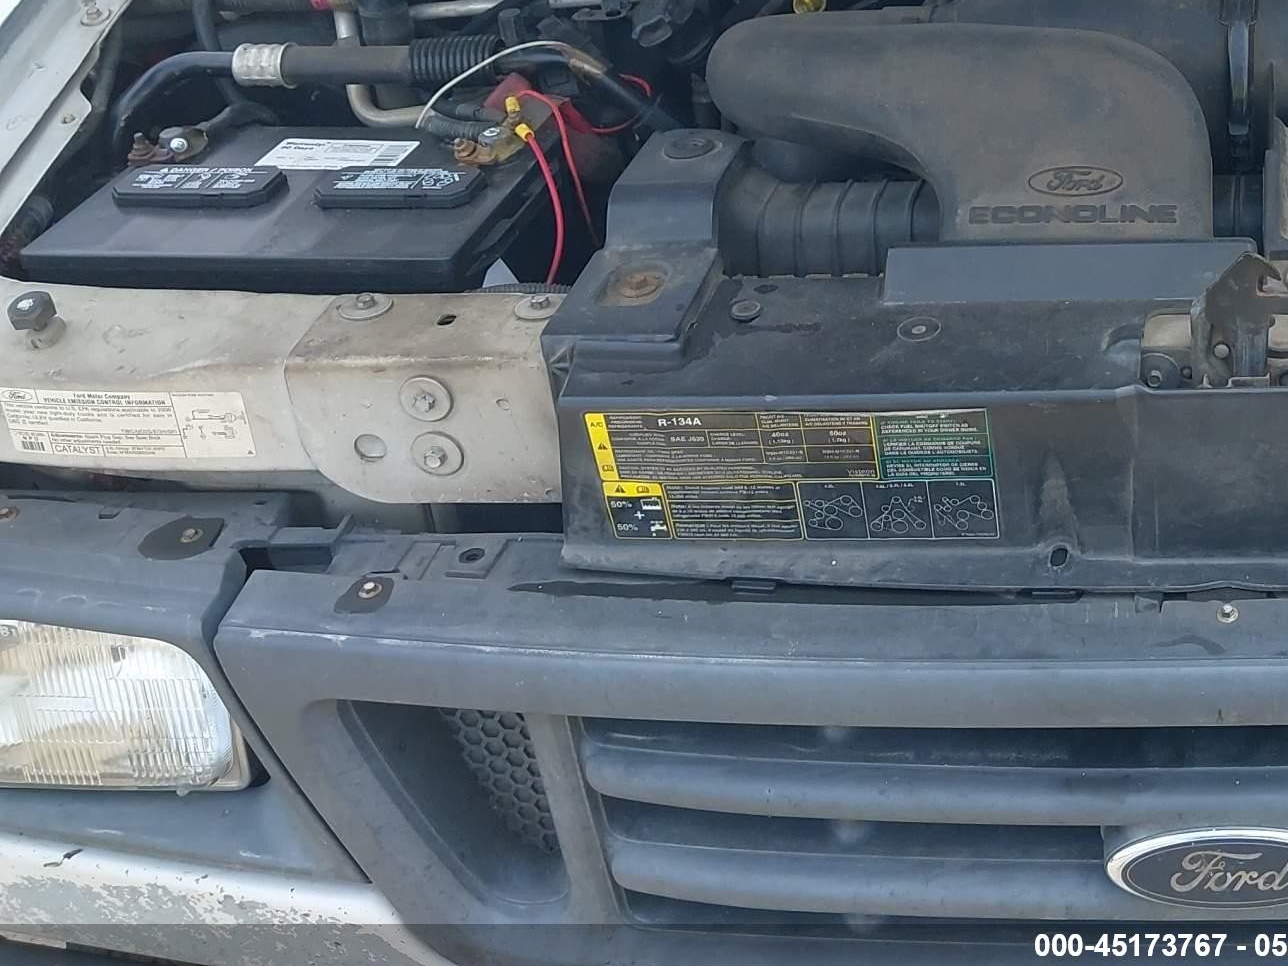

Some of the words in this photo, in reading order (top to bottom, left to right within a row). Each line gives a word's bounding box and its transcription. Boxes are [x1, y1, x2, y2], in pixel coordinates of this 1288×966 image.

[1046, 169, 1105, 192] Ford
[967, 204, 1179, 225] ECONOLINE
[590, 421, 604, 429] A/C
[658, 417, 702, 427] R-134A
[54, 444, 101, 455] CATALYST
[610, 500, 633, 509] 50%
[617, 523, 639, 531] 50%
